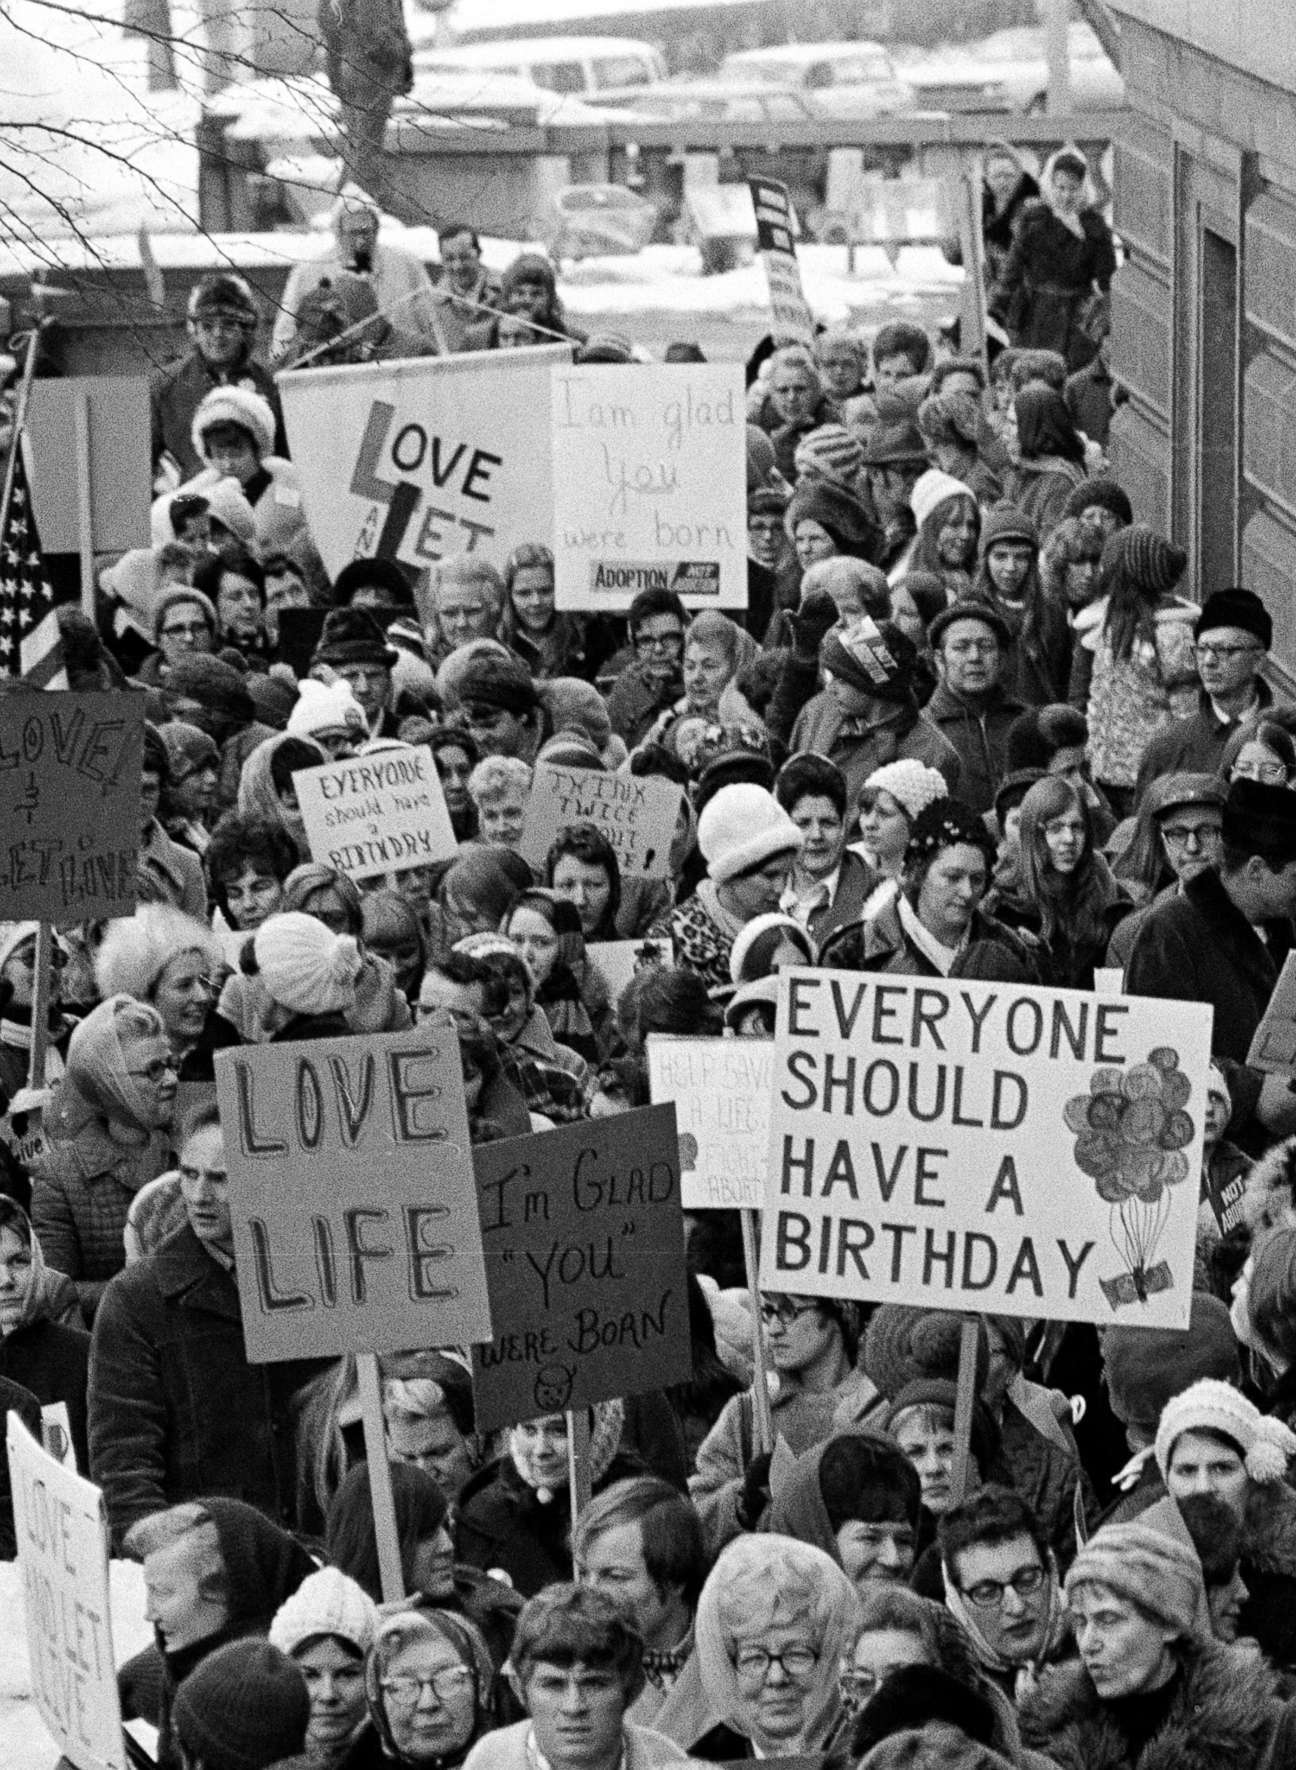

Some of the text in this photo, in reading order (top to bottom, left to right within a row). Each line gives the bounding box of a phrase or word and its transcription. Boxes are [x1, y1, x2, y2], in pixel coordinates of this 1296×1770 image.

[350, 400, 504, 504] LOVE
[559, 377, 736, 450] I am glad
[562, 507, 736, 550] were born
[595, 562, 669, 589] ADOPTION
[319, 757, 425, 800] EVERYONE
[547, 770, 646, 805] THINK
[559, 797, 637, 823] TWICE
[328, 830, 433, 871] BIRTHDAY
[787, 977, 1129, 1064] EVERYONE
[234, 1047, 449, 1158] LOVE
[780, 1050, 1029, 1131] SHOULD
[482, 1148, 674, 1233] I'm GLAD
[780, 1134, 1025, 1216] HAVE A
[1221, 1174, 1244, 1208] NOT
[248, 1203, 459, 1316] LIFE
[775, 1210, 1096, 1299] BIRTHDAY
[480, 1289, 672, 1369] WERE BORN
